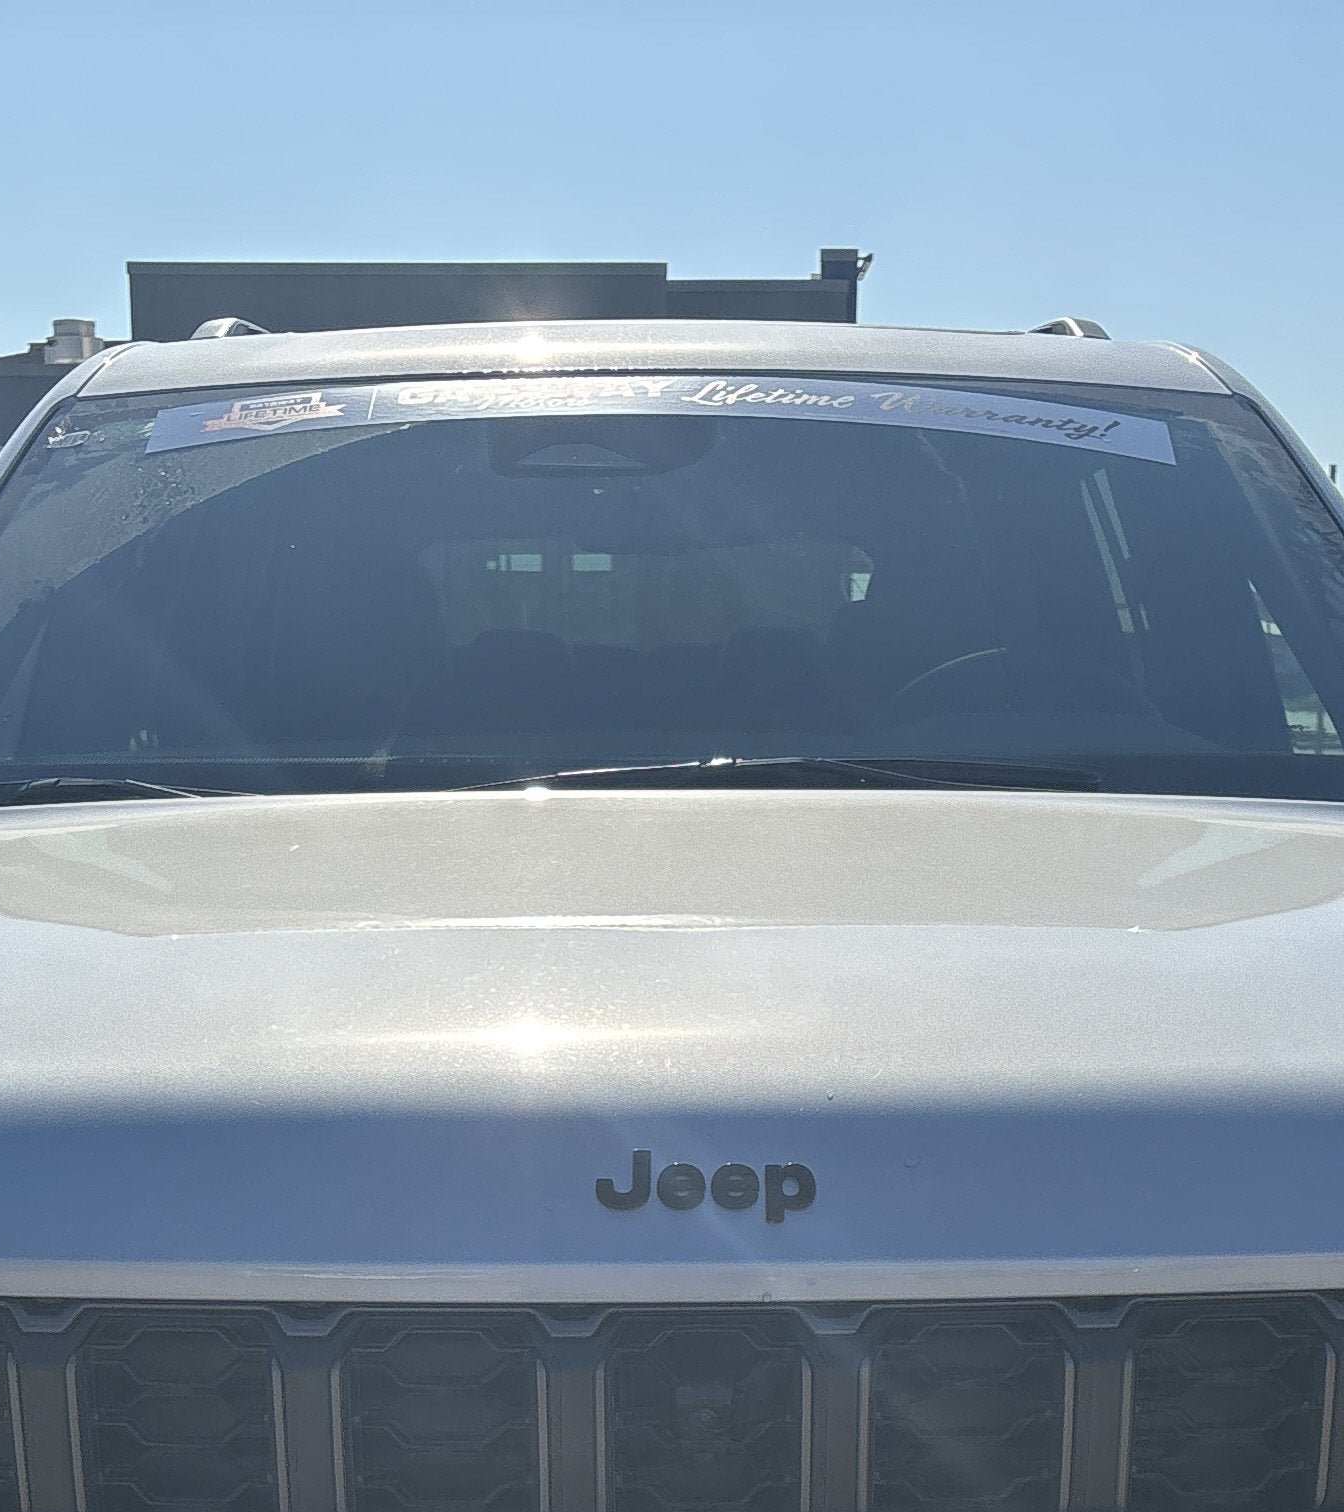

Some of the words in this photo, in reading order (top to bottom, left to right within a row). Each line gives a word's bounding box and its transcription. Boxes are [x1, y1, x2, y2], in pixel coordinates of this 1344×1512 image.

[226, 404, 321, 422] LIFETIME
[681, 380, 856, 410] Lifetime
[871, 391, 1121, 441] Warranty!
[595, 1149, 817, 1224] Jeep
